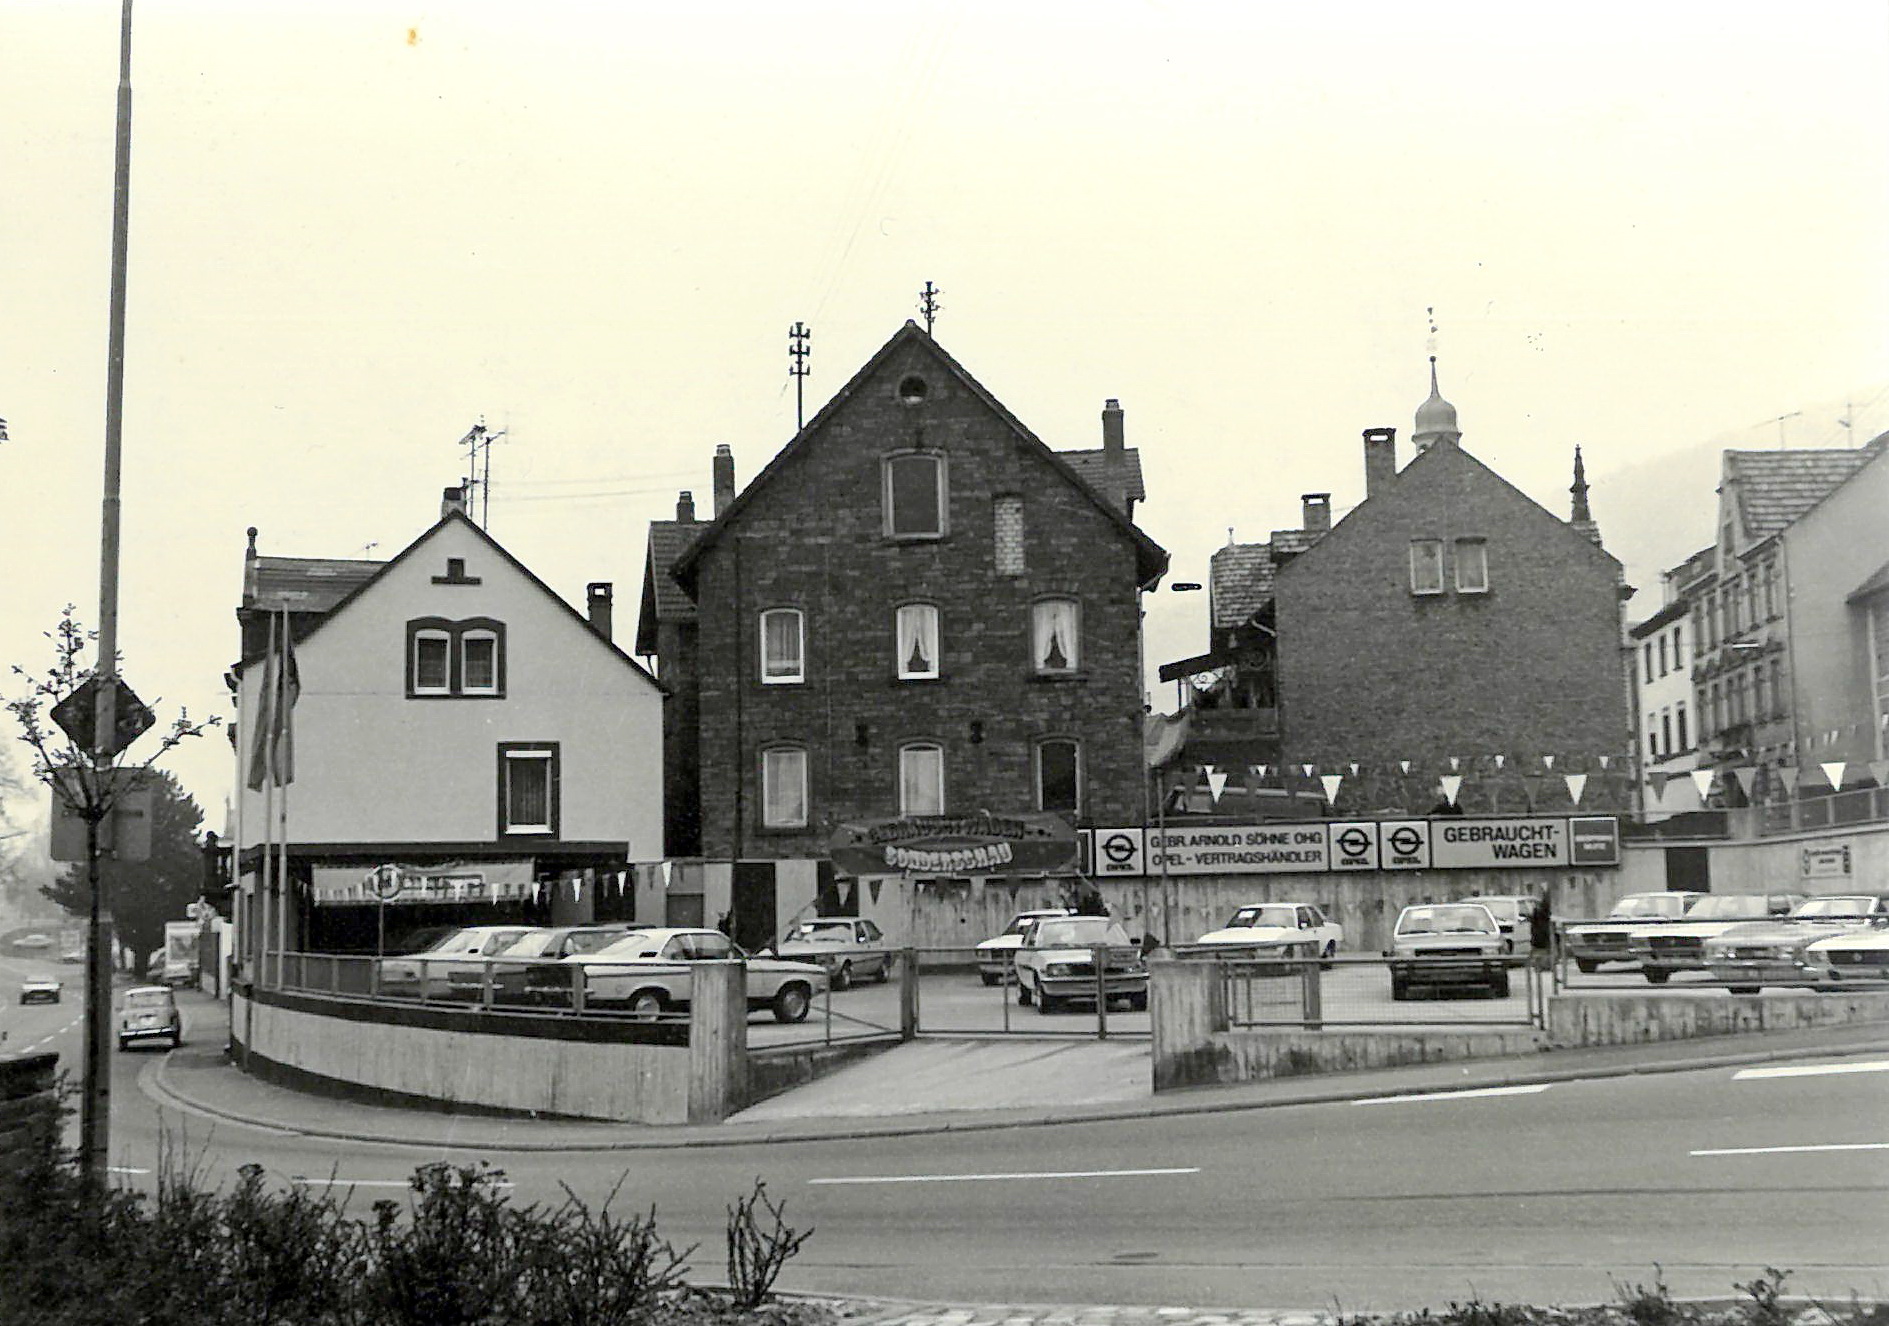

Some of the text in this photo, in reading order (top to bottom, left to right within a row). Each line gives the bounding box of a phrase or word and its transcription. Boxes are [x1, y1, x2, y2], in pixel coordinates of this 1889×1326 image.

[1190, 834, 1242, 846] ARNOLD
[1246, 831, 1290, 845] SÖHNE
[1294, 831, 1322, 844] OHG
[1443, 825, 1560, 842] GEBRAUCHT-
[1491, 843, 1557, 859] WAGEN
